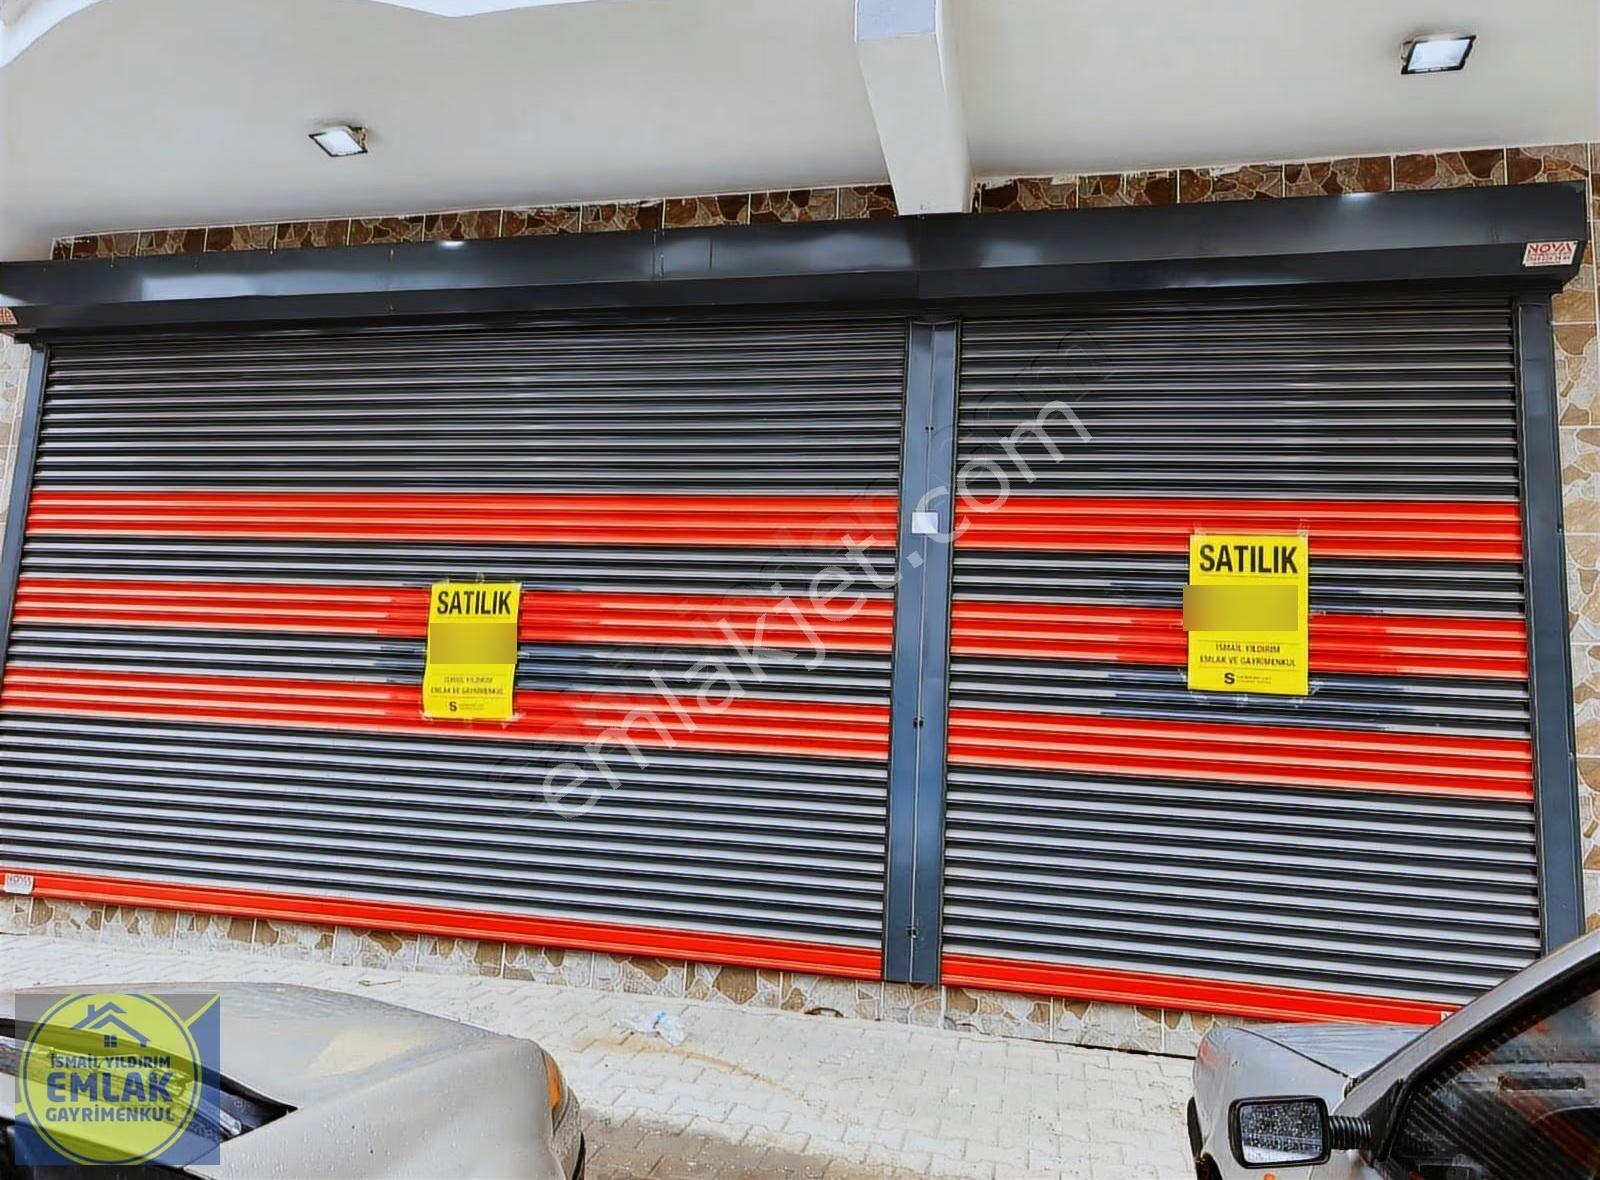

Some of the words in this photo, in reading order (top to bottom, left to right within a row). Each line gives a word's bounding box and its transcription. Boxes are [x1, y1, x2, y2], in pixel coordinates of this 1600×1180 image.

[1528, 242, 1572, 254] NOVA
[1199, 544, 1299, 574] SATILIK
[437, 590, 512, 615] SATILIK
